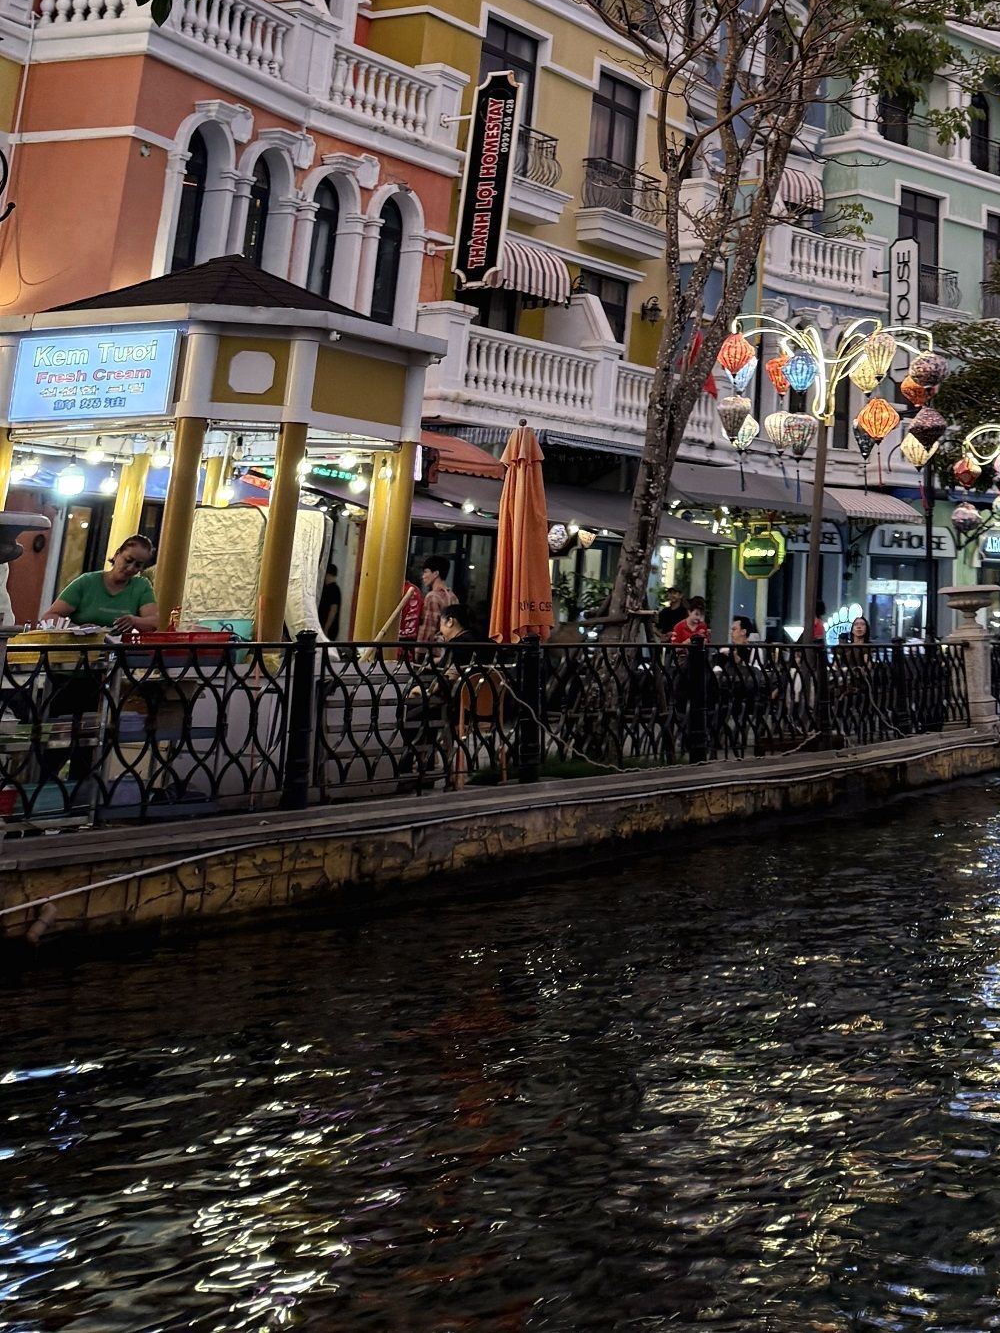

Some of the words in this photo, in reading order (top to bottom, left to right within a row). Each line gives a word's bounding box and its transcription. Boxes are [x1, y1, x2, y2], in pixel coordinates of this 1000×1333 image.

[479, 97, 505, 178] HOMESTAY
[475, 180, 498, 210] LỢI
[467, 211, 490, 269] THÀNH
[34, 345, 89, 367] Kem
[98, 340, 158, 364] Tươi
[36, 369, 87, 384] Fresh
[92, 368, 151, 382] Cream
